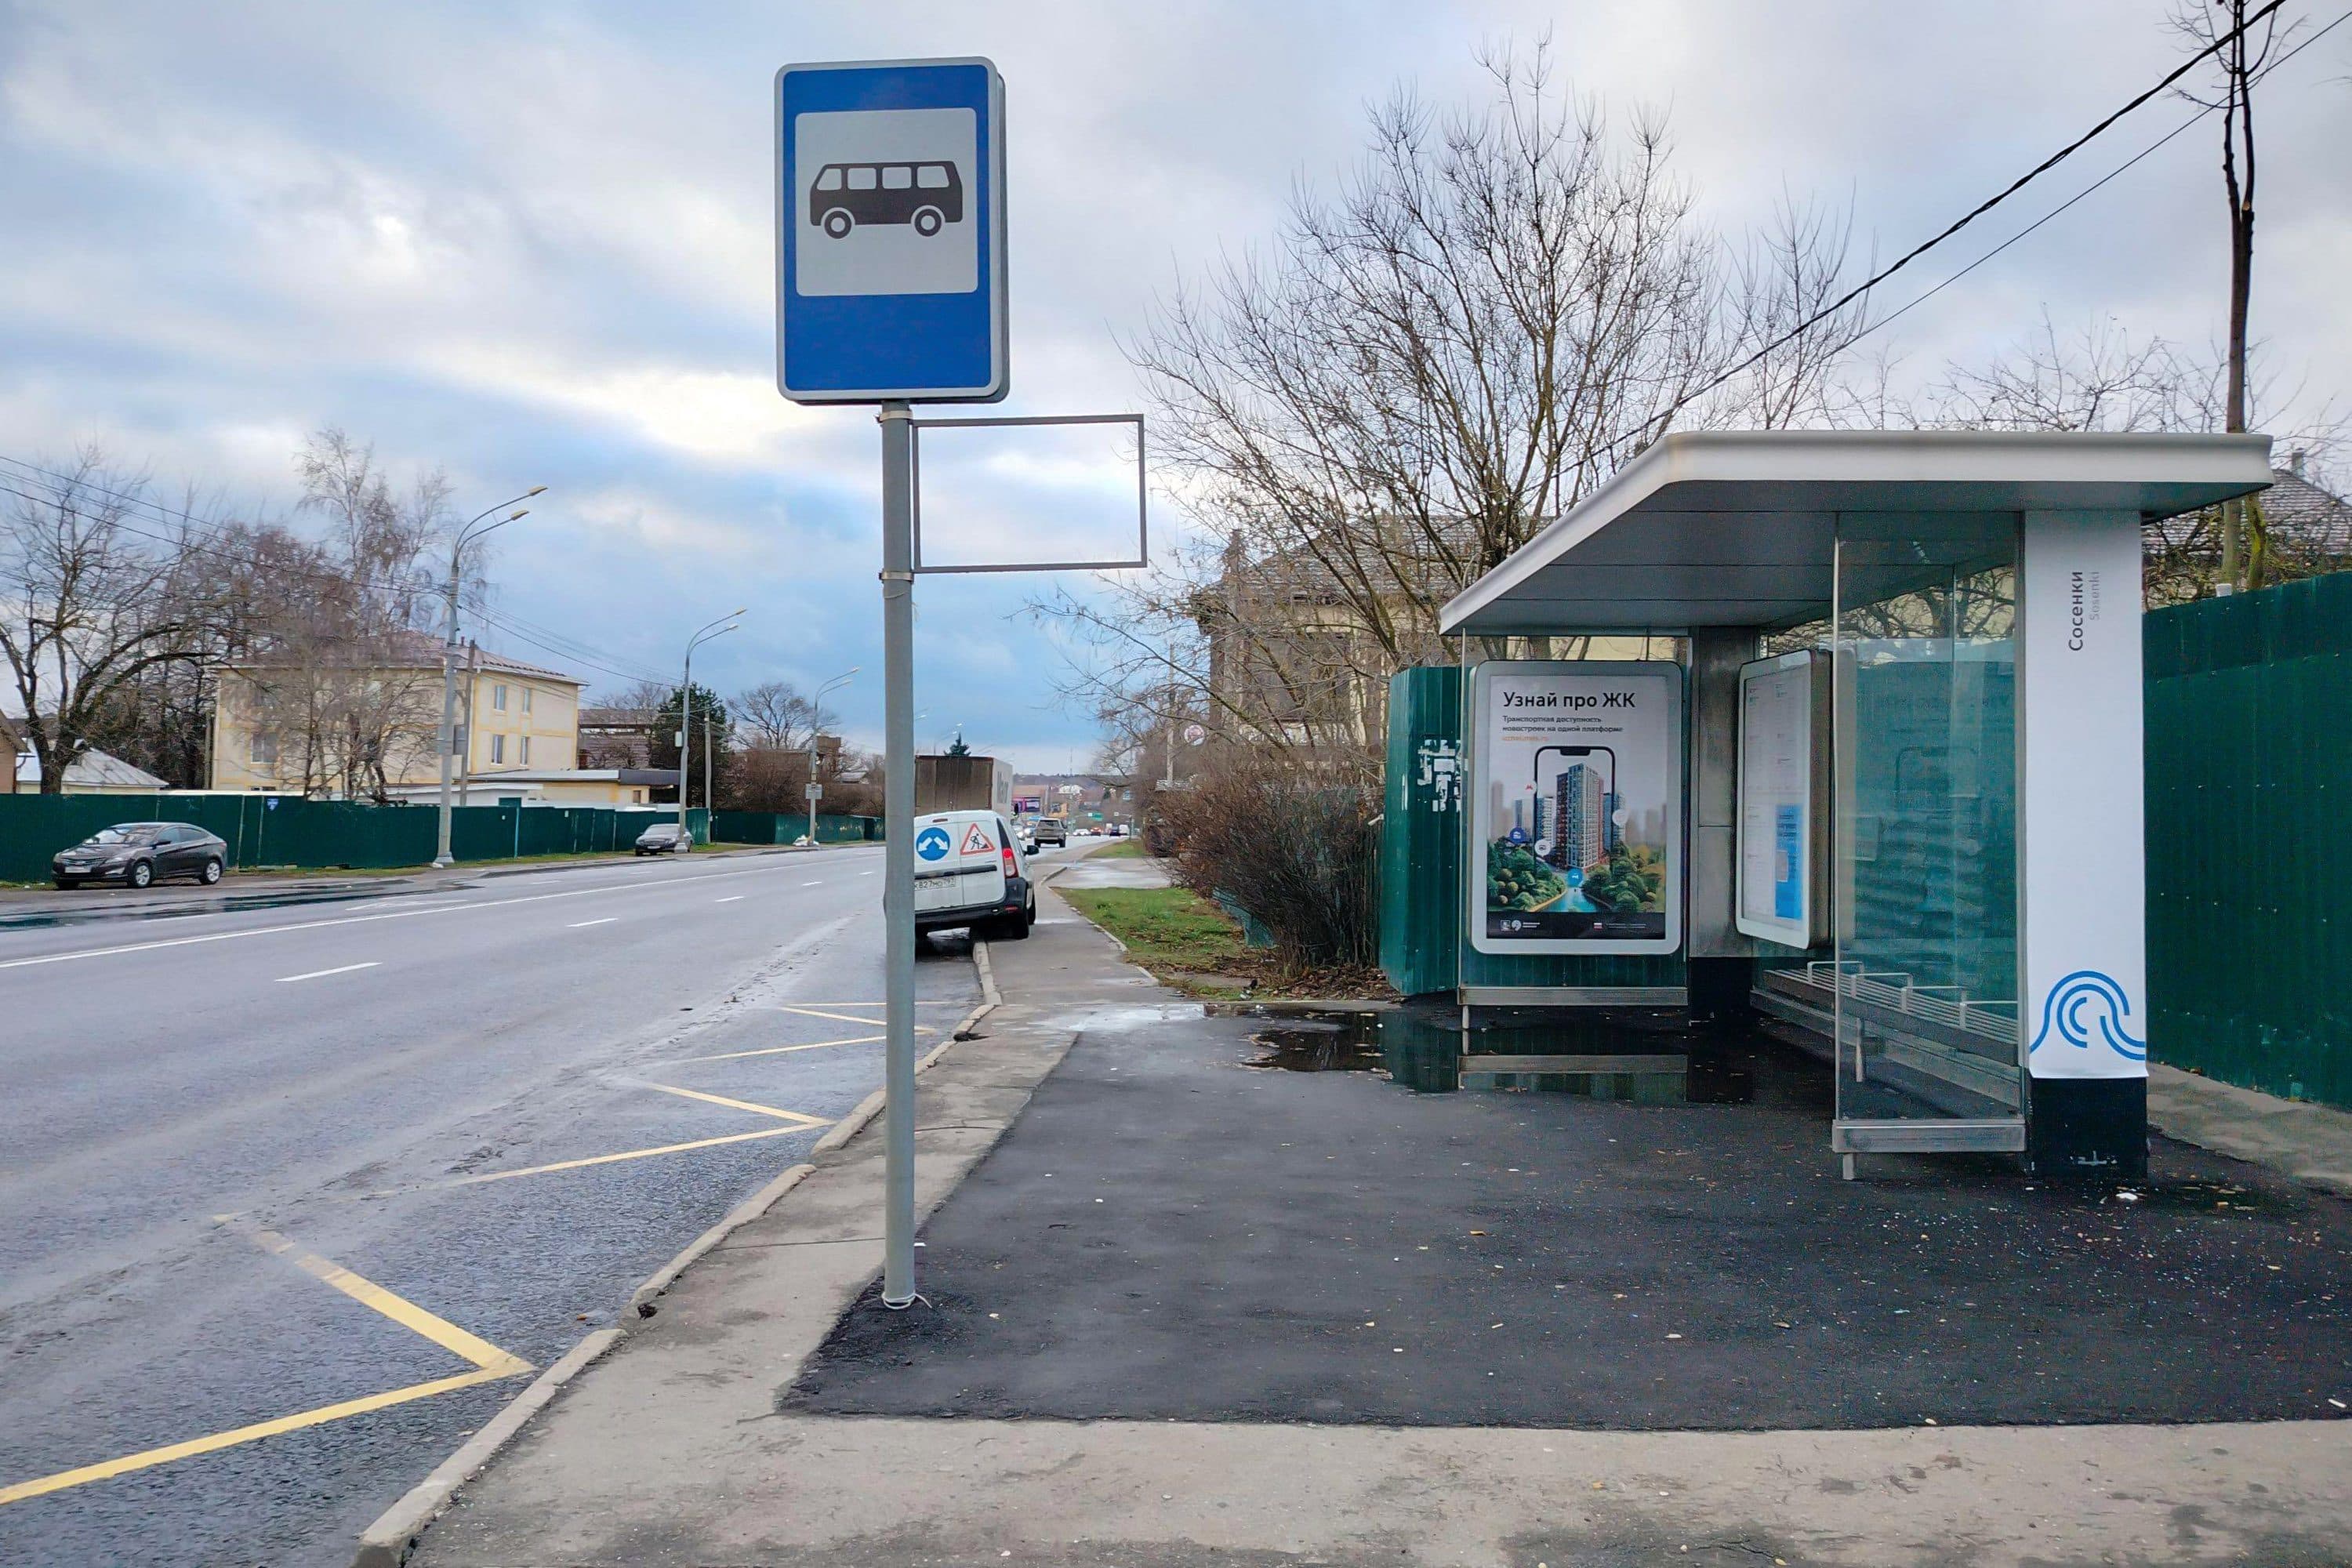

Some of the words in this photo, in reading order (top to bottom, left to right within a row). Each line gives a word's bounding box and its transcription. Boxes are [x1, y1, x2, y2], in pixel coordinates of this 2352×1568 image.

[2068, 572, 2083, 652] Сосенки
[1502, 691, 1557, 708] Узнай
[1563, 695, 1598, 710] про
[1602, 691, 1636, 708] ЖК
[1502, 715, 1555, 724] Транспортная
